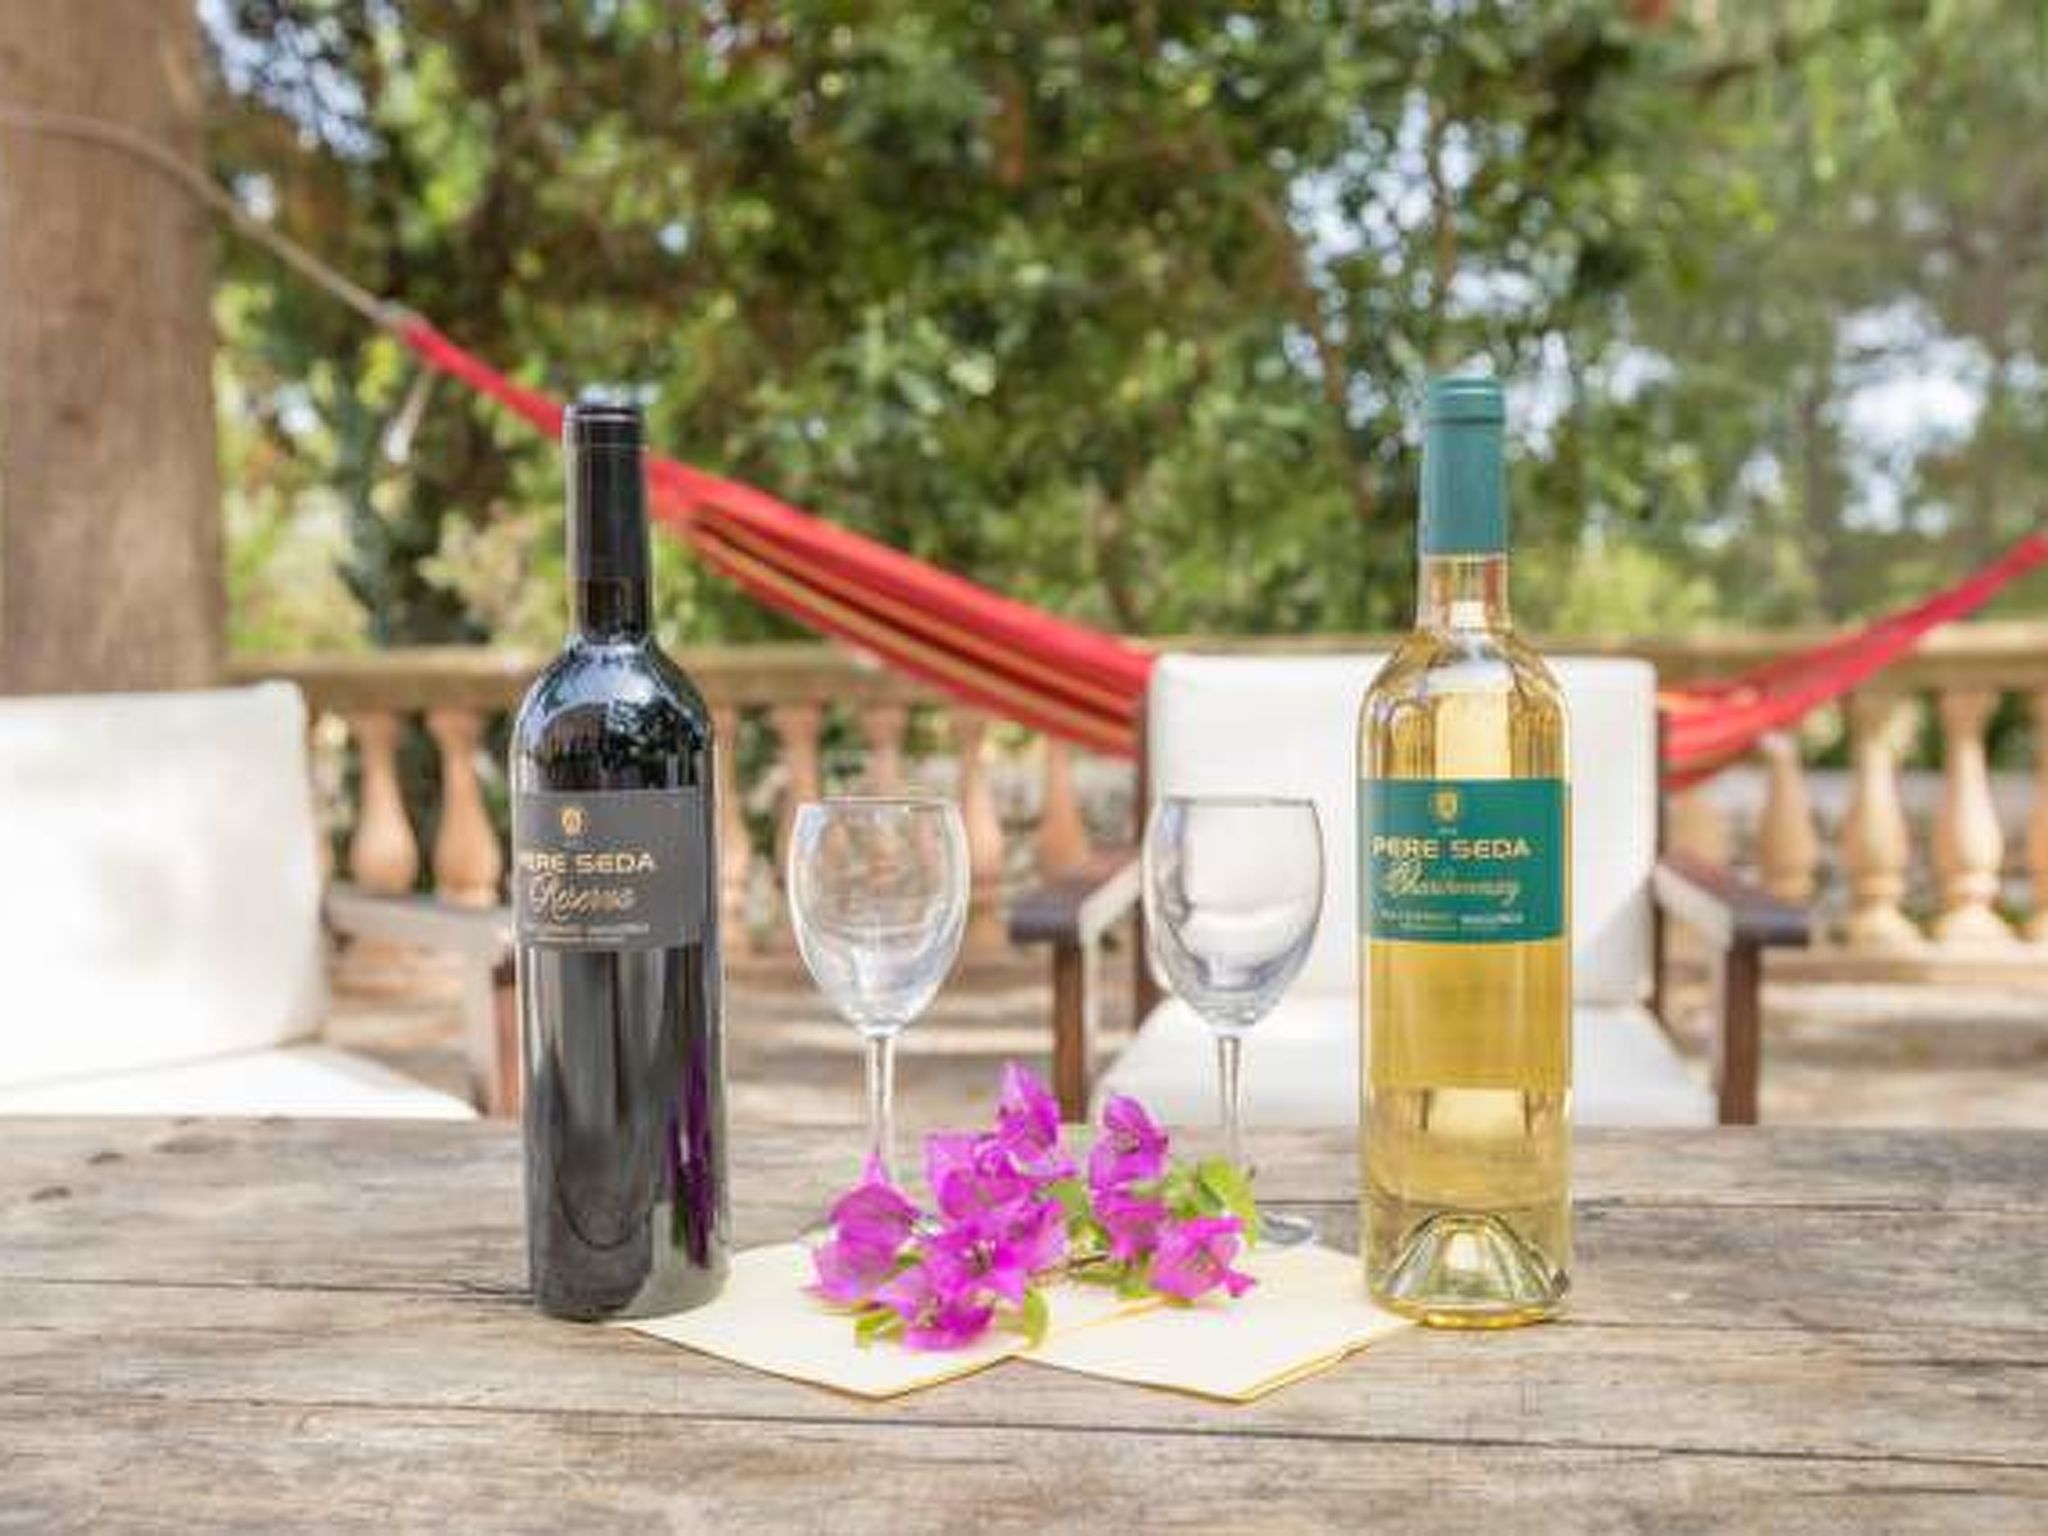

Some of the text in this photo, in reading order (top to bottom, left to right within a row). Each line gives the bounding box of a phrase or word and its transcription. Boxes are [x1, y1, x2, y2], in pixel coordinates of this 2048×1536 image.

[1371, 837, 1532, 860] PERE SEDA
[575, 853, 656, 873] SEDA
